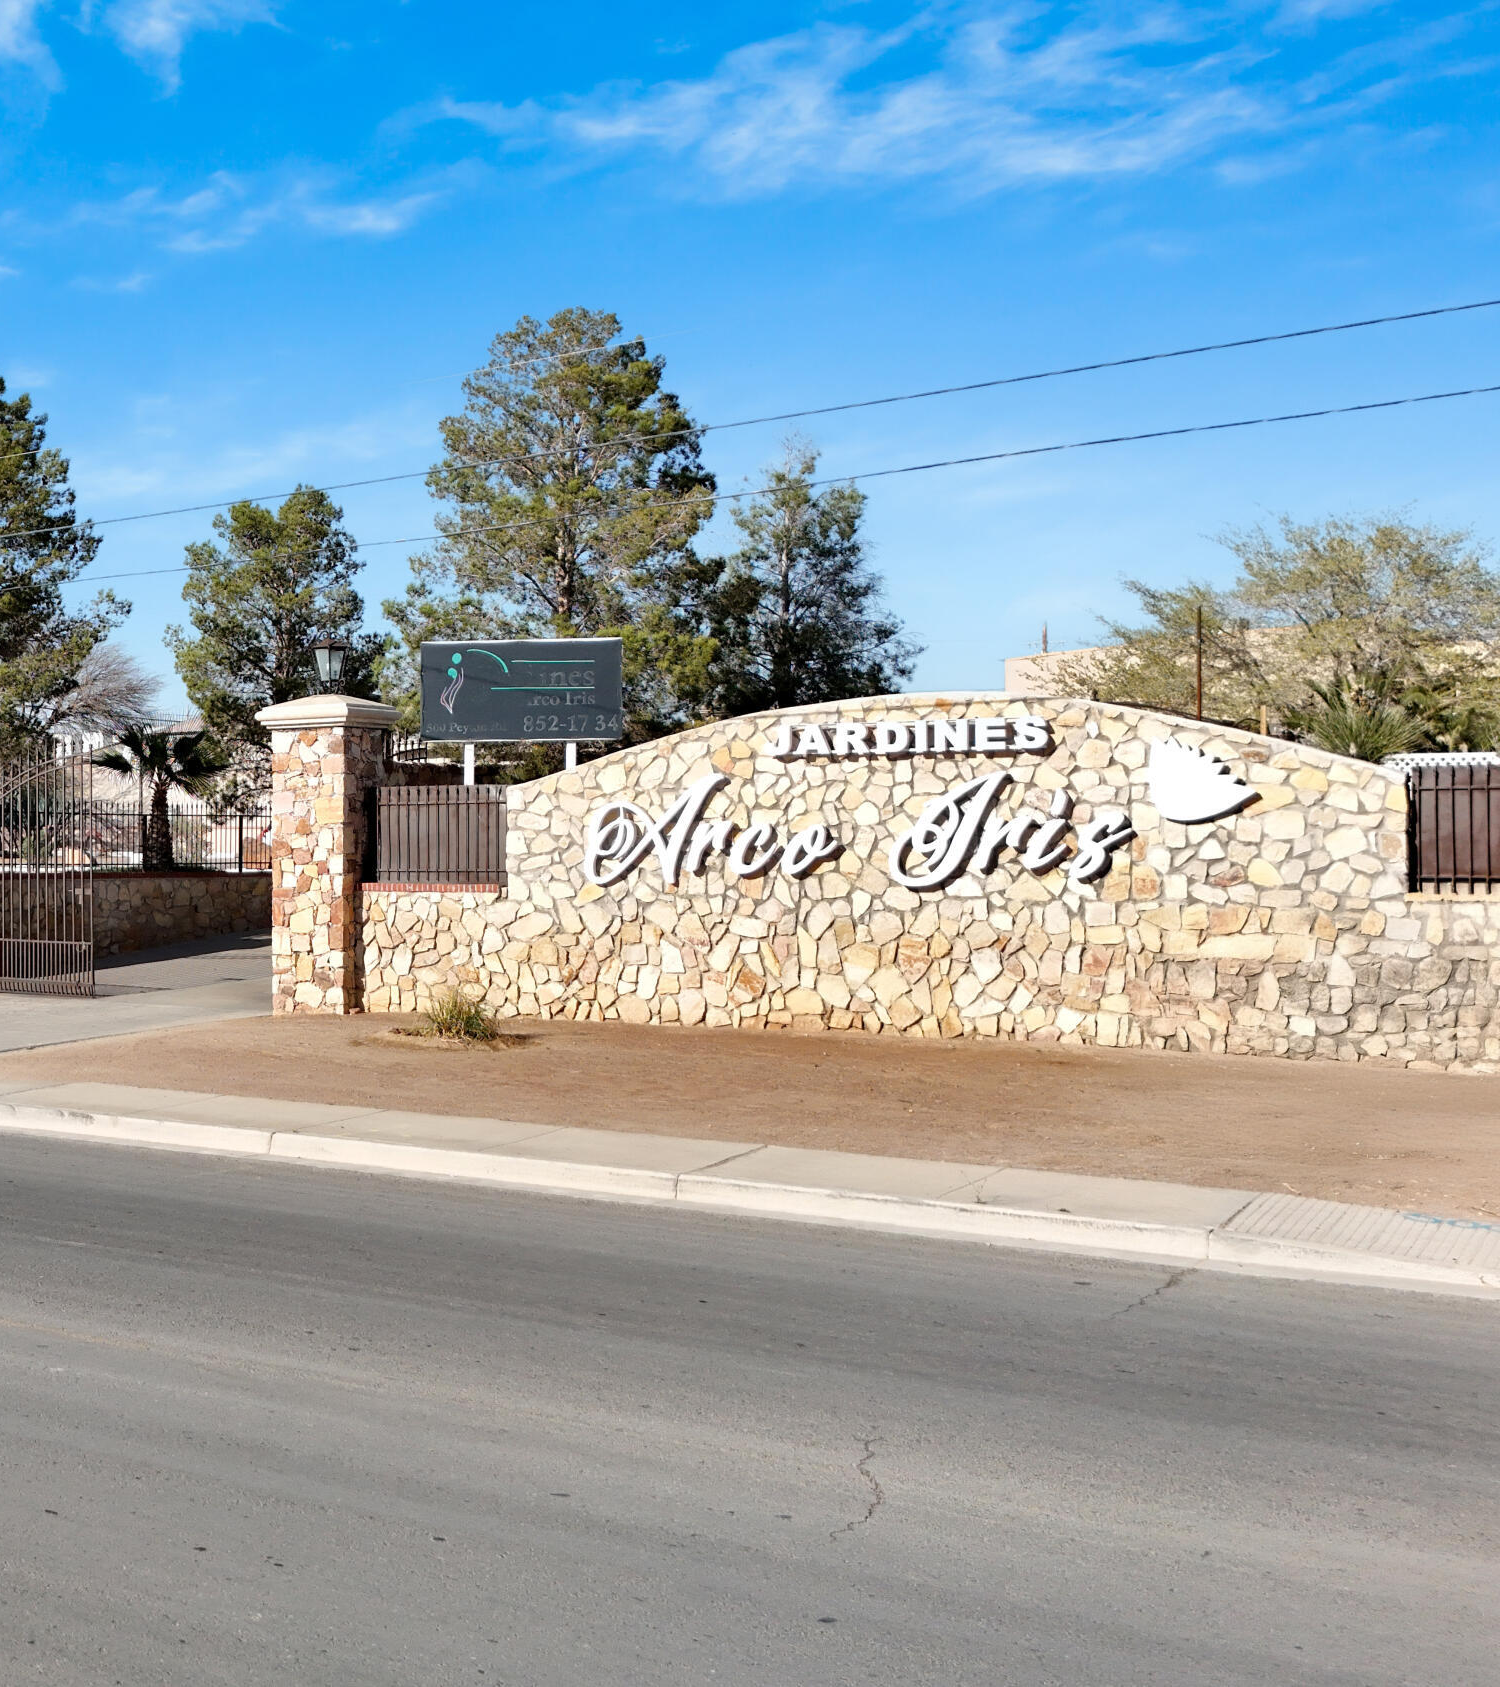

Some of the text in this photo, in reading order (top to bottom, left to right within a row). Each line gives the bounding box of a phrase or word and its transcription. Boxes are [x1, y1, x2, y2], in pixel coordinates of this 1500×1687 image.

[527, 691, 596, 706] rco Iris
[773, 716, 1053, 757] JARDINES
[584, 770, 1137, 891] Arco Iris
